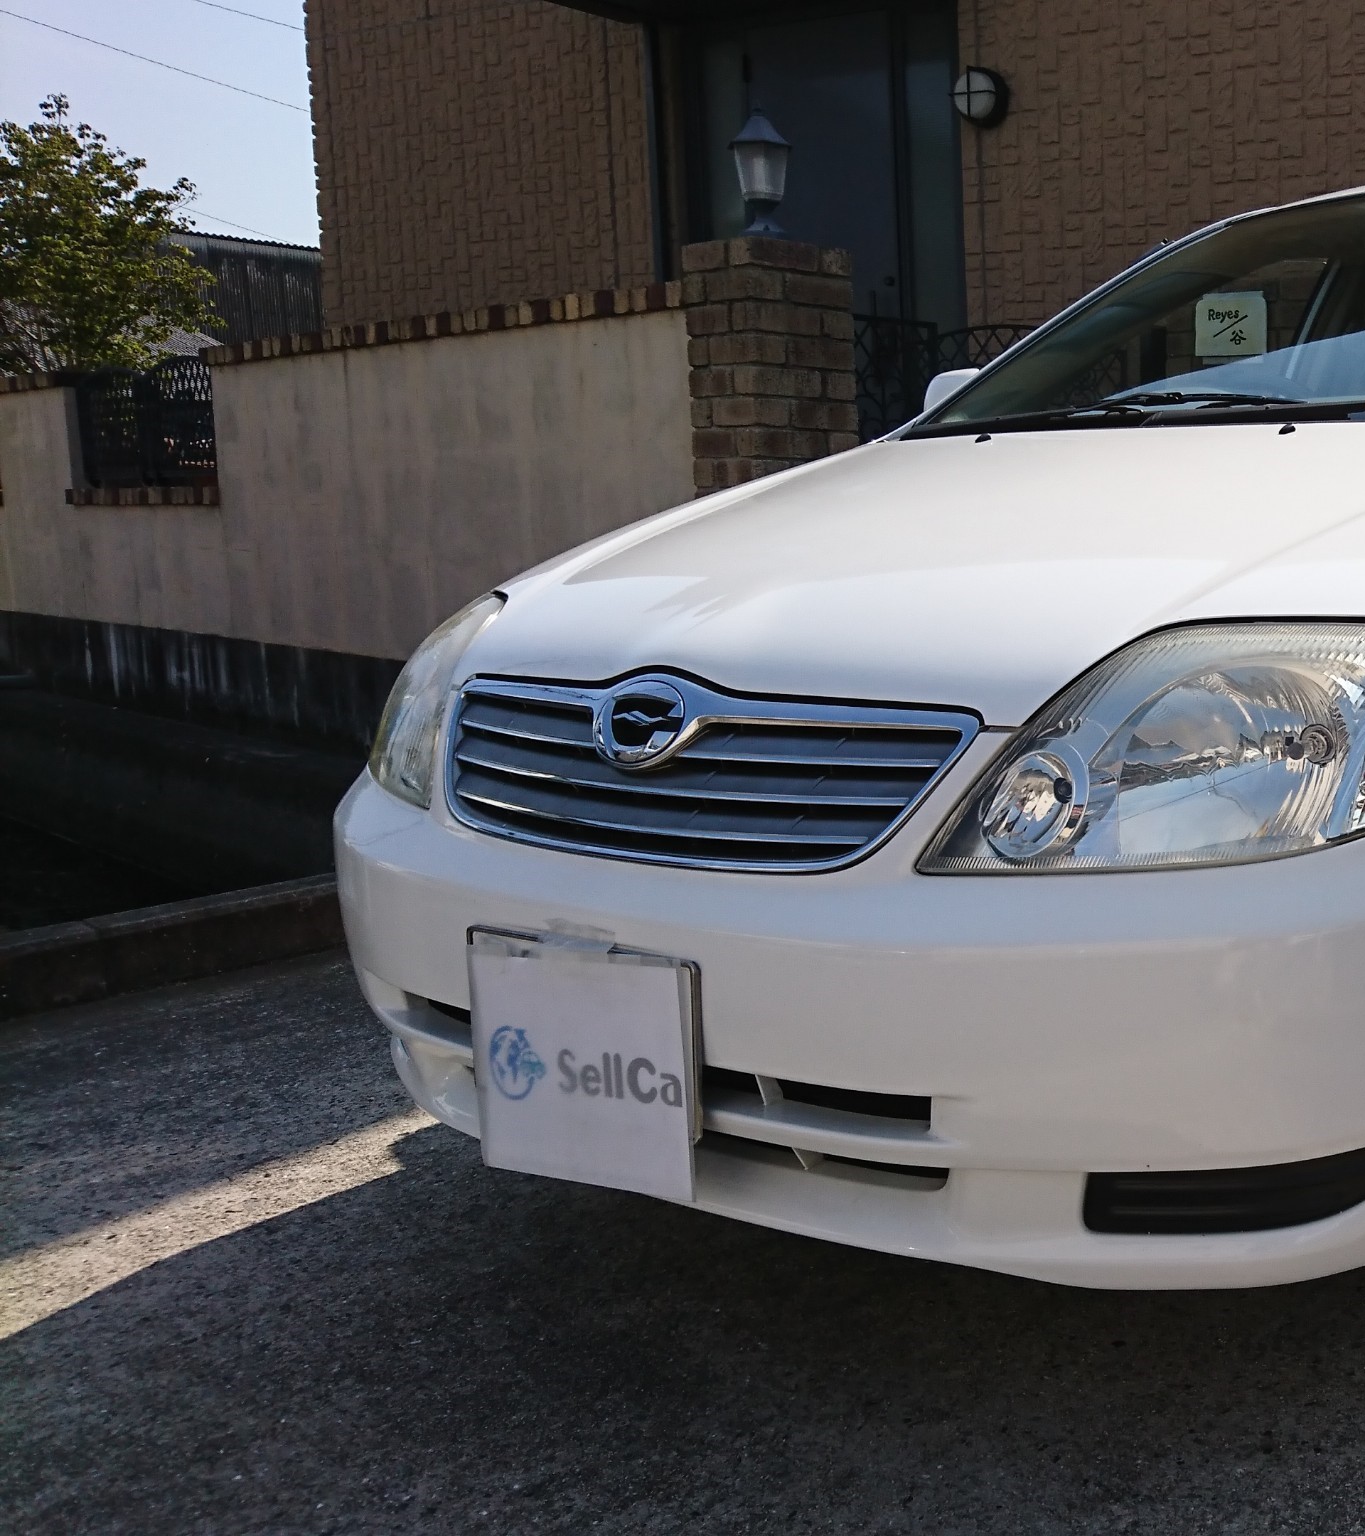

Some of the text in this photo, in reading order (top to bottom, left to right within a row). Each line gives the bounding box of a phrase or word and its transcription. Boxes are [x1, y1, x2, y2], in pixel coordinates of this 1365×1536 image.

[1208, 309, 1240, 323] Reyes
[1230, 329, 1247, 345] 谷
[557, 1048, 683, 1108] SellCa
